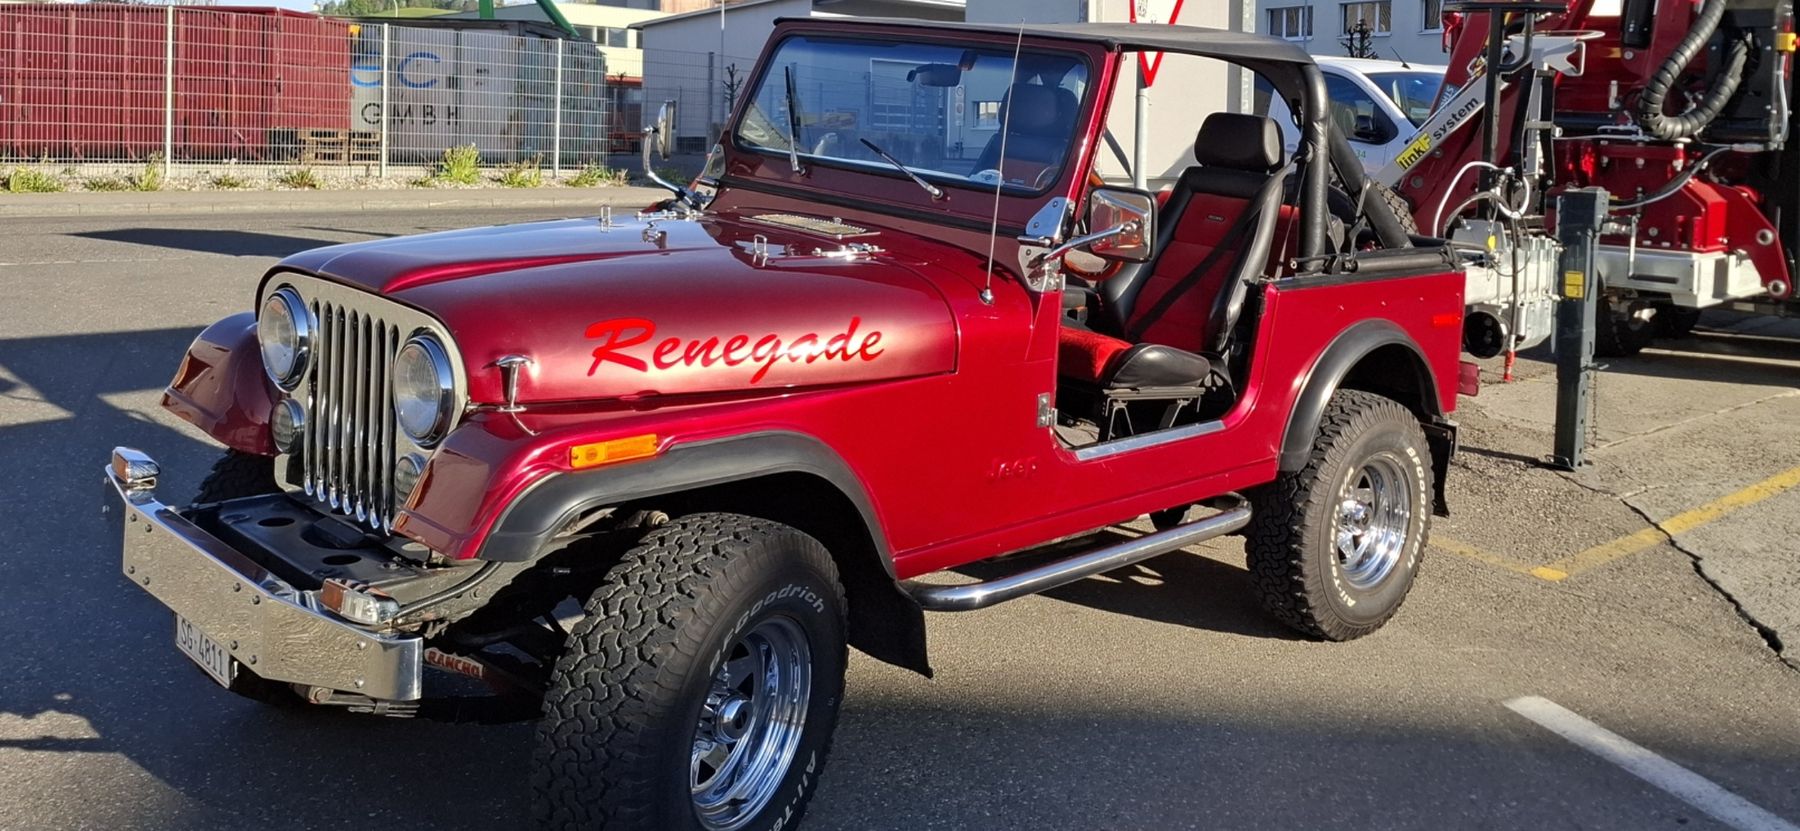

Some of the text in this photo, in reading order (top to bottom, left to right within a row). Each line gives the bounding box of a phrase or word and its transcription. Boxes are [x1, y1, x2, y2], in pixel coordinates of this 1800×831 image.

[1432, 98, 1479, 140] system
[584, 316, 885, 385] Renegade
[428, 651, 480, 676] RANCHO
